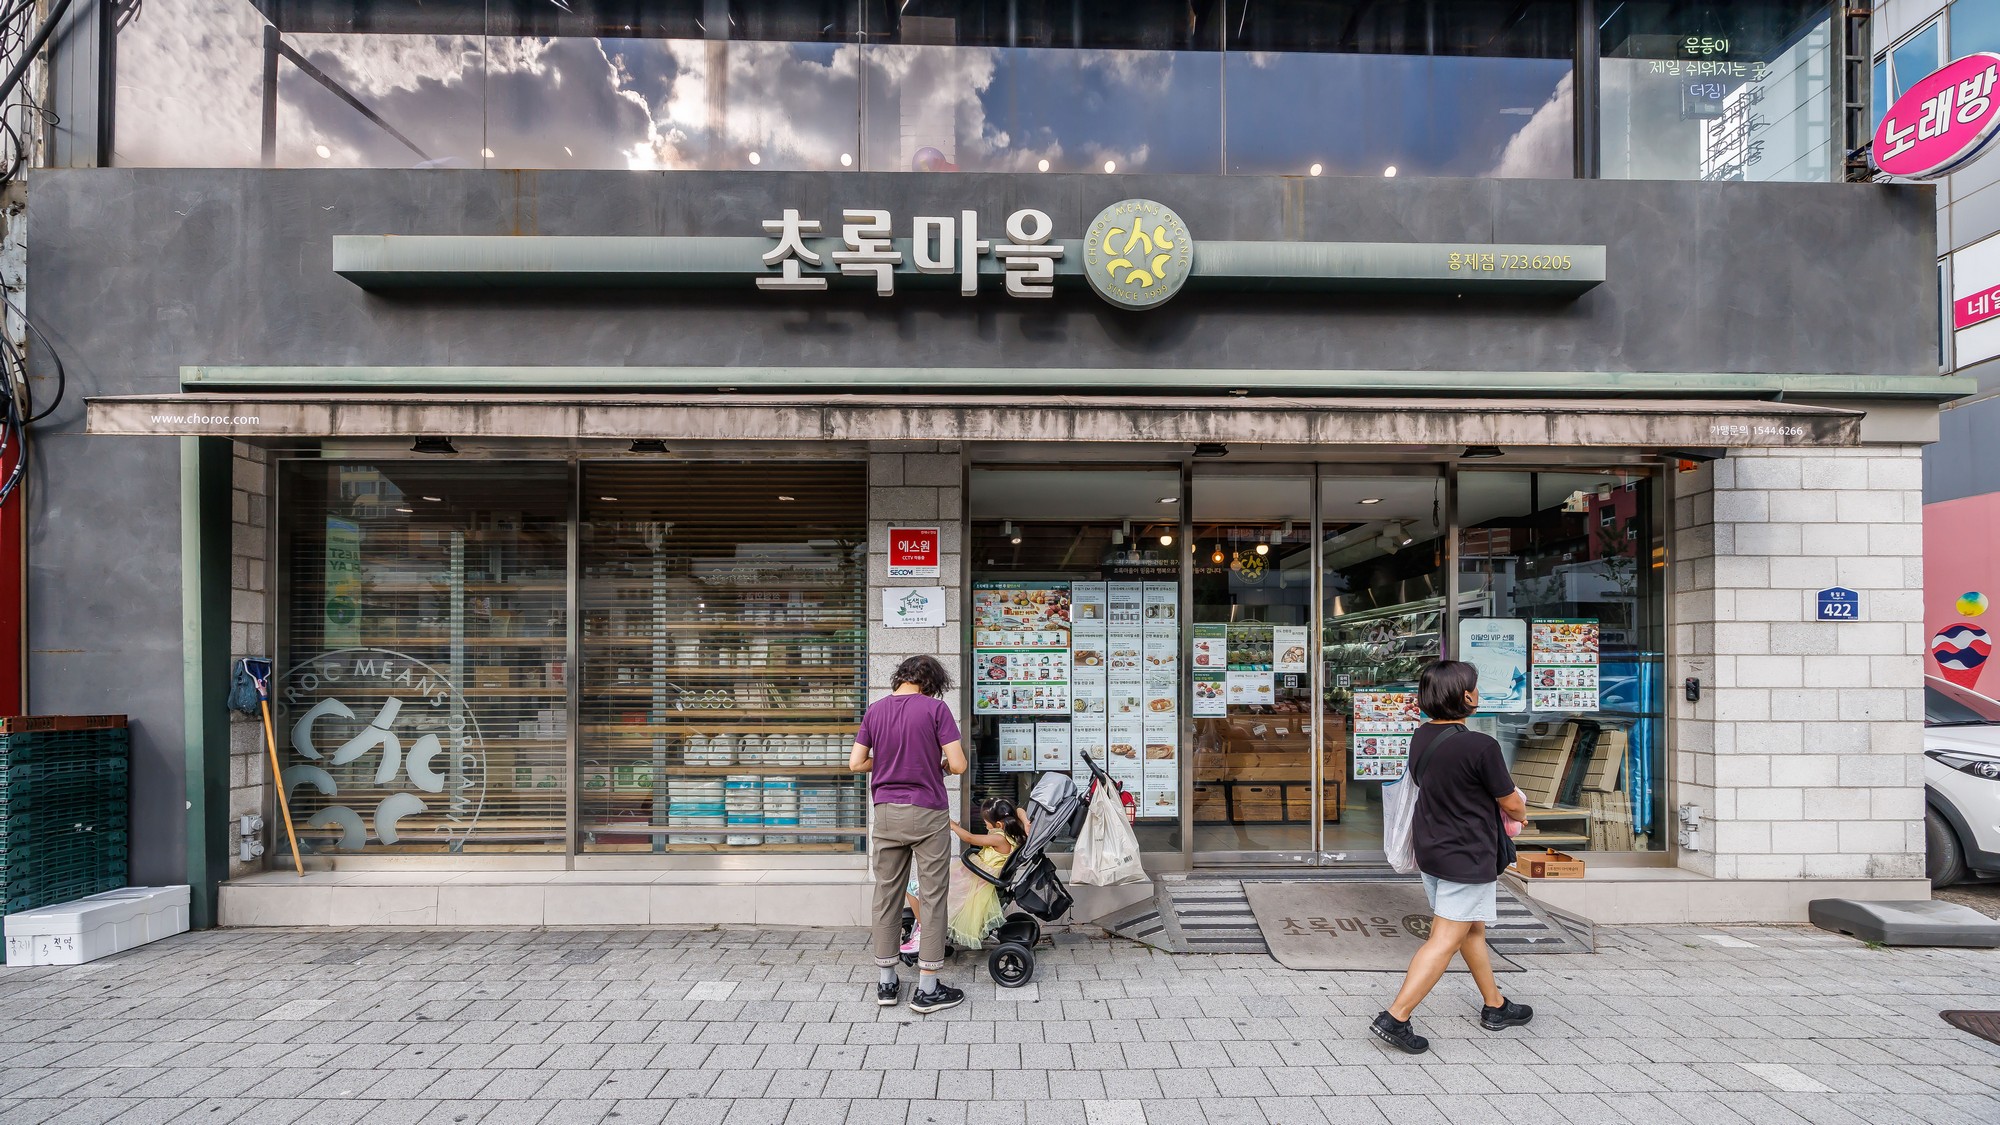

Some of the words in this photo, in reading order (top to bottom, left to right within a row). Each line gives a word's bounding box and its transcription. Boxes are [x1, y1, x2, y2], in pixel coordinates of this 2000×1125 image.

[1684, 37, 1729, 55] 운동이
[1649, 60, 1680, 76] 제일
[1686, 61, 1747, 77] 쉬워지는
[1690, 83, 1726, 99] 더짐!
[1882, 63, 1999, 162] 노래방
[1088, 213, 1112, 265] CHOROC
[1115, 203, 1159, 217] MEANS
[1163, 213, 1190, 268] ORGANIC
[755, 208, 1065, 299] 초록마을
[1447, 252, 1495, 271] 홍제점
[1500, 254, 1572, 271] 723.6205
[1106, 282, 1138, 300] SINCE
[1144, 284, 1168, 299] 1999
[150, 413, 260, 425] www.choroc.com
[1710, 425, 1749, 436] 가맹문의
[1753, 426, 1803, 436] 1544.6266
[898, 540, 930, 553] 에스원
[1823, 603, 1852, 617] 422
[354, 659, 448, 707] MEANS
[434, 714, 478, 842] ORGANIC
[1278, 916, 1401, 938] 초록마을
